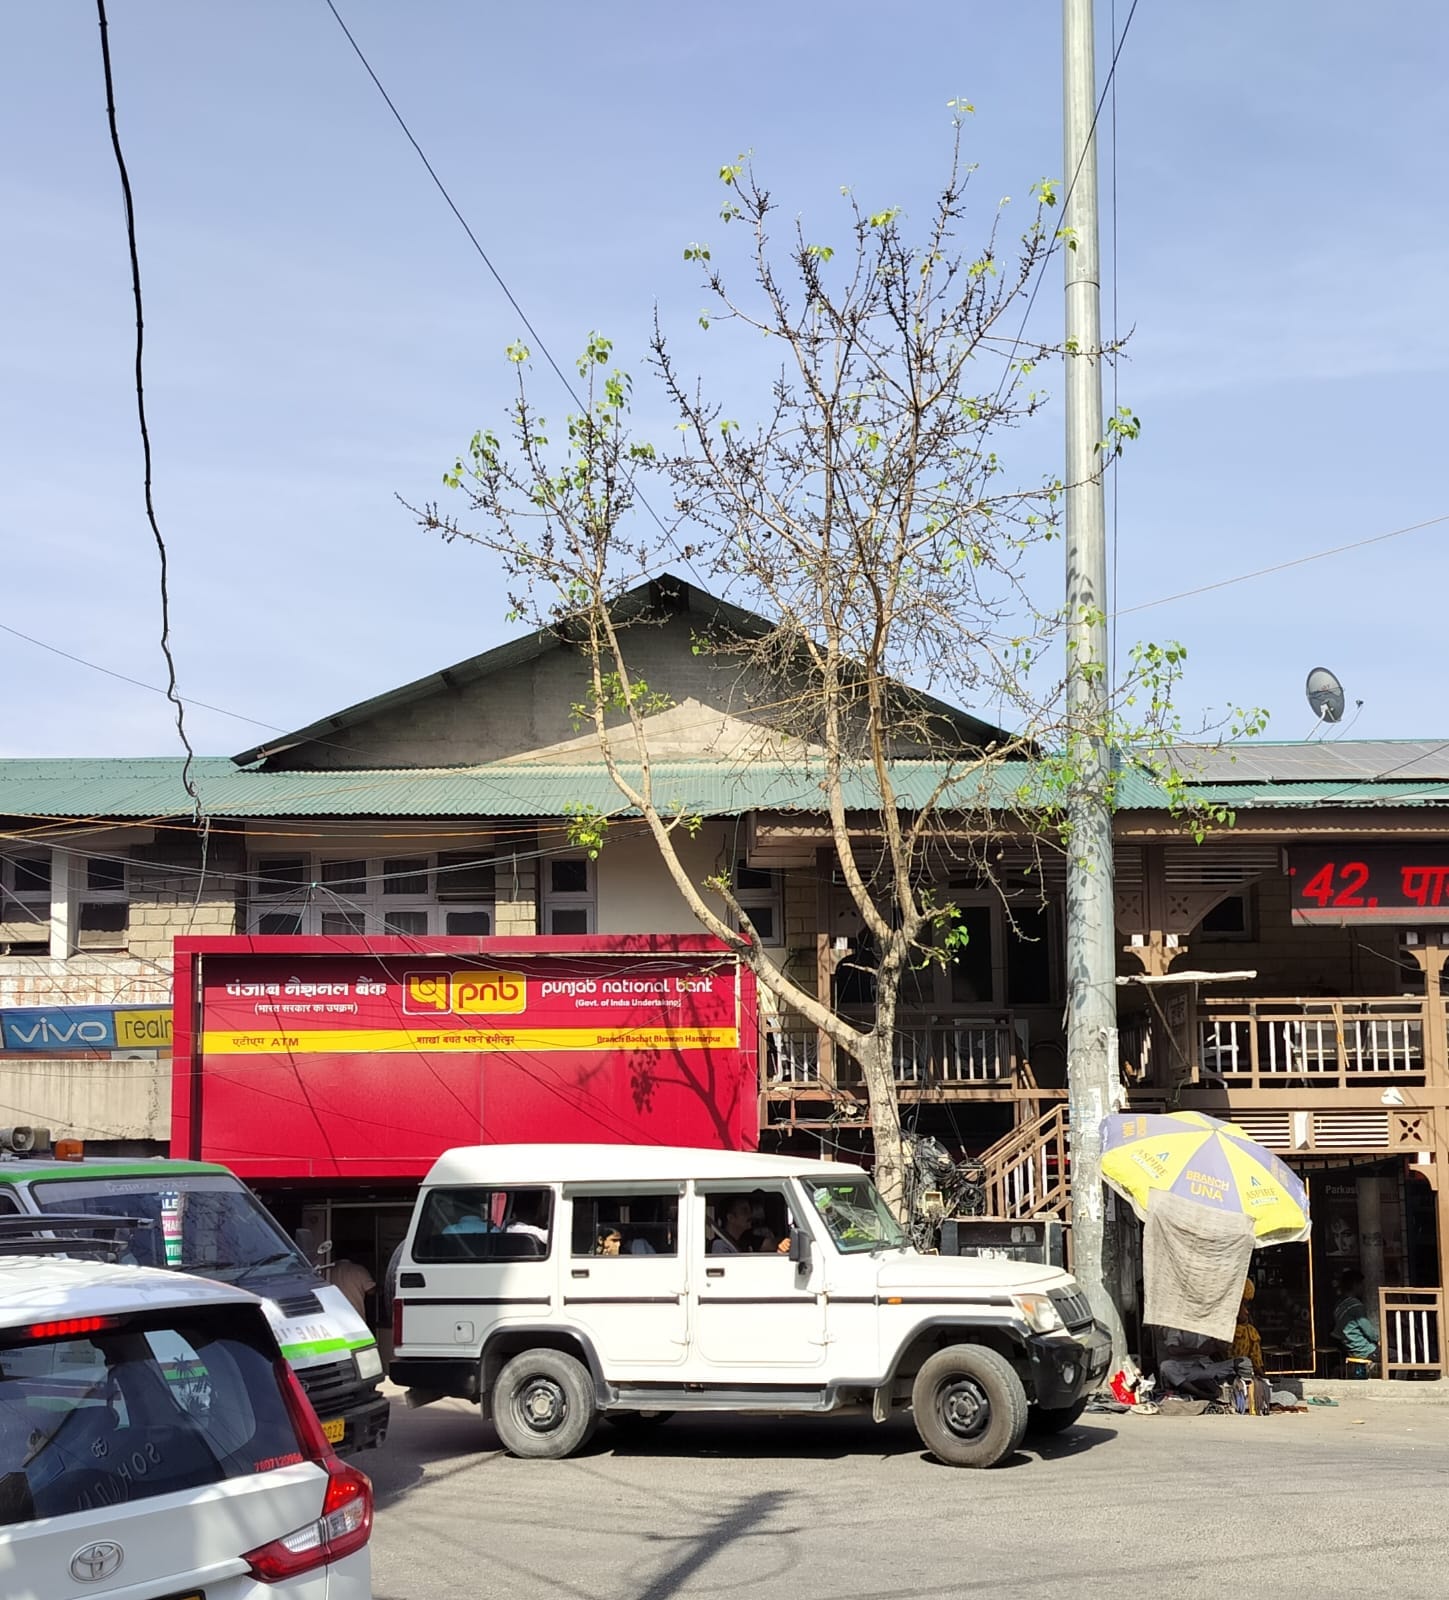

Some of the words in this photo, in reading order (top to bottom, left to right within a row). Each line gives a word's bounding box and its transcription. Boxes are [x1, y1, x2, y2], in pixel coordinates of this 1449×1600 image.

[1401, 866, 1449, 907] पा
[226, 978, 280, 997] पंजाब
[284, 975, 349, 998] नैशनल
[355, 975, 387, 997] बैंक
[458, 975, 519, 1009] pnb
[541, 979, 597, 997] punjab
[602, 979, 670, 993] national
[675, 978, 713, 993] bank
[254, 1002, 280, 1015] (भारत
[282, 1003, 311, 1013] सरकार
[312, 1003, 324, 1013] का
[325, 1002, 359, 1015] उपक्रम)
[575, 999, 599, 1008] (Govt.
[600, 999, 609, 1007] of
[610, 999, 630, 1007] India
[10, 1016, 107, 1043] vivo
[231, 1036, 264, 1047] एटीएम
[270, 1037, 299, 1047] ATM
[1190, 1182, 1224, 1202] UNA
